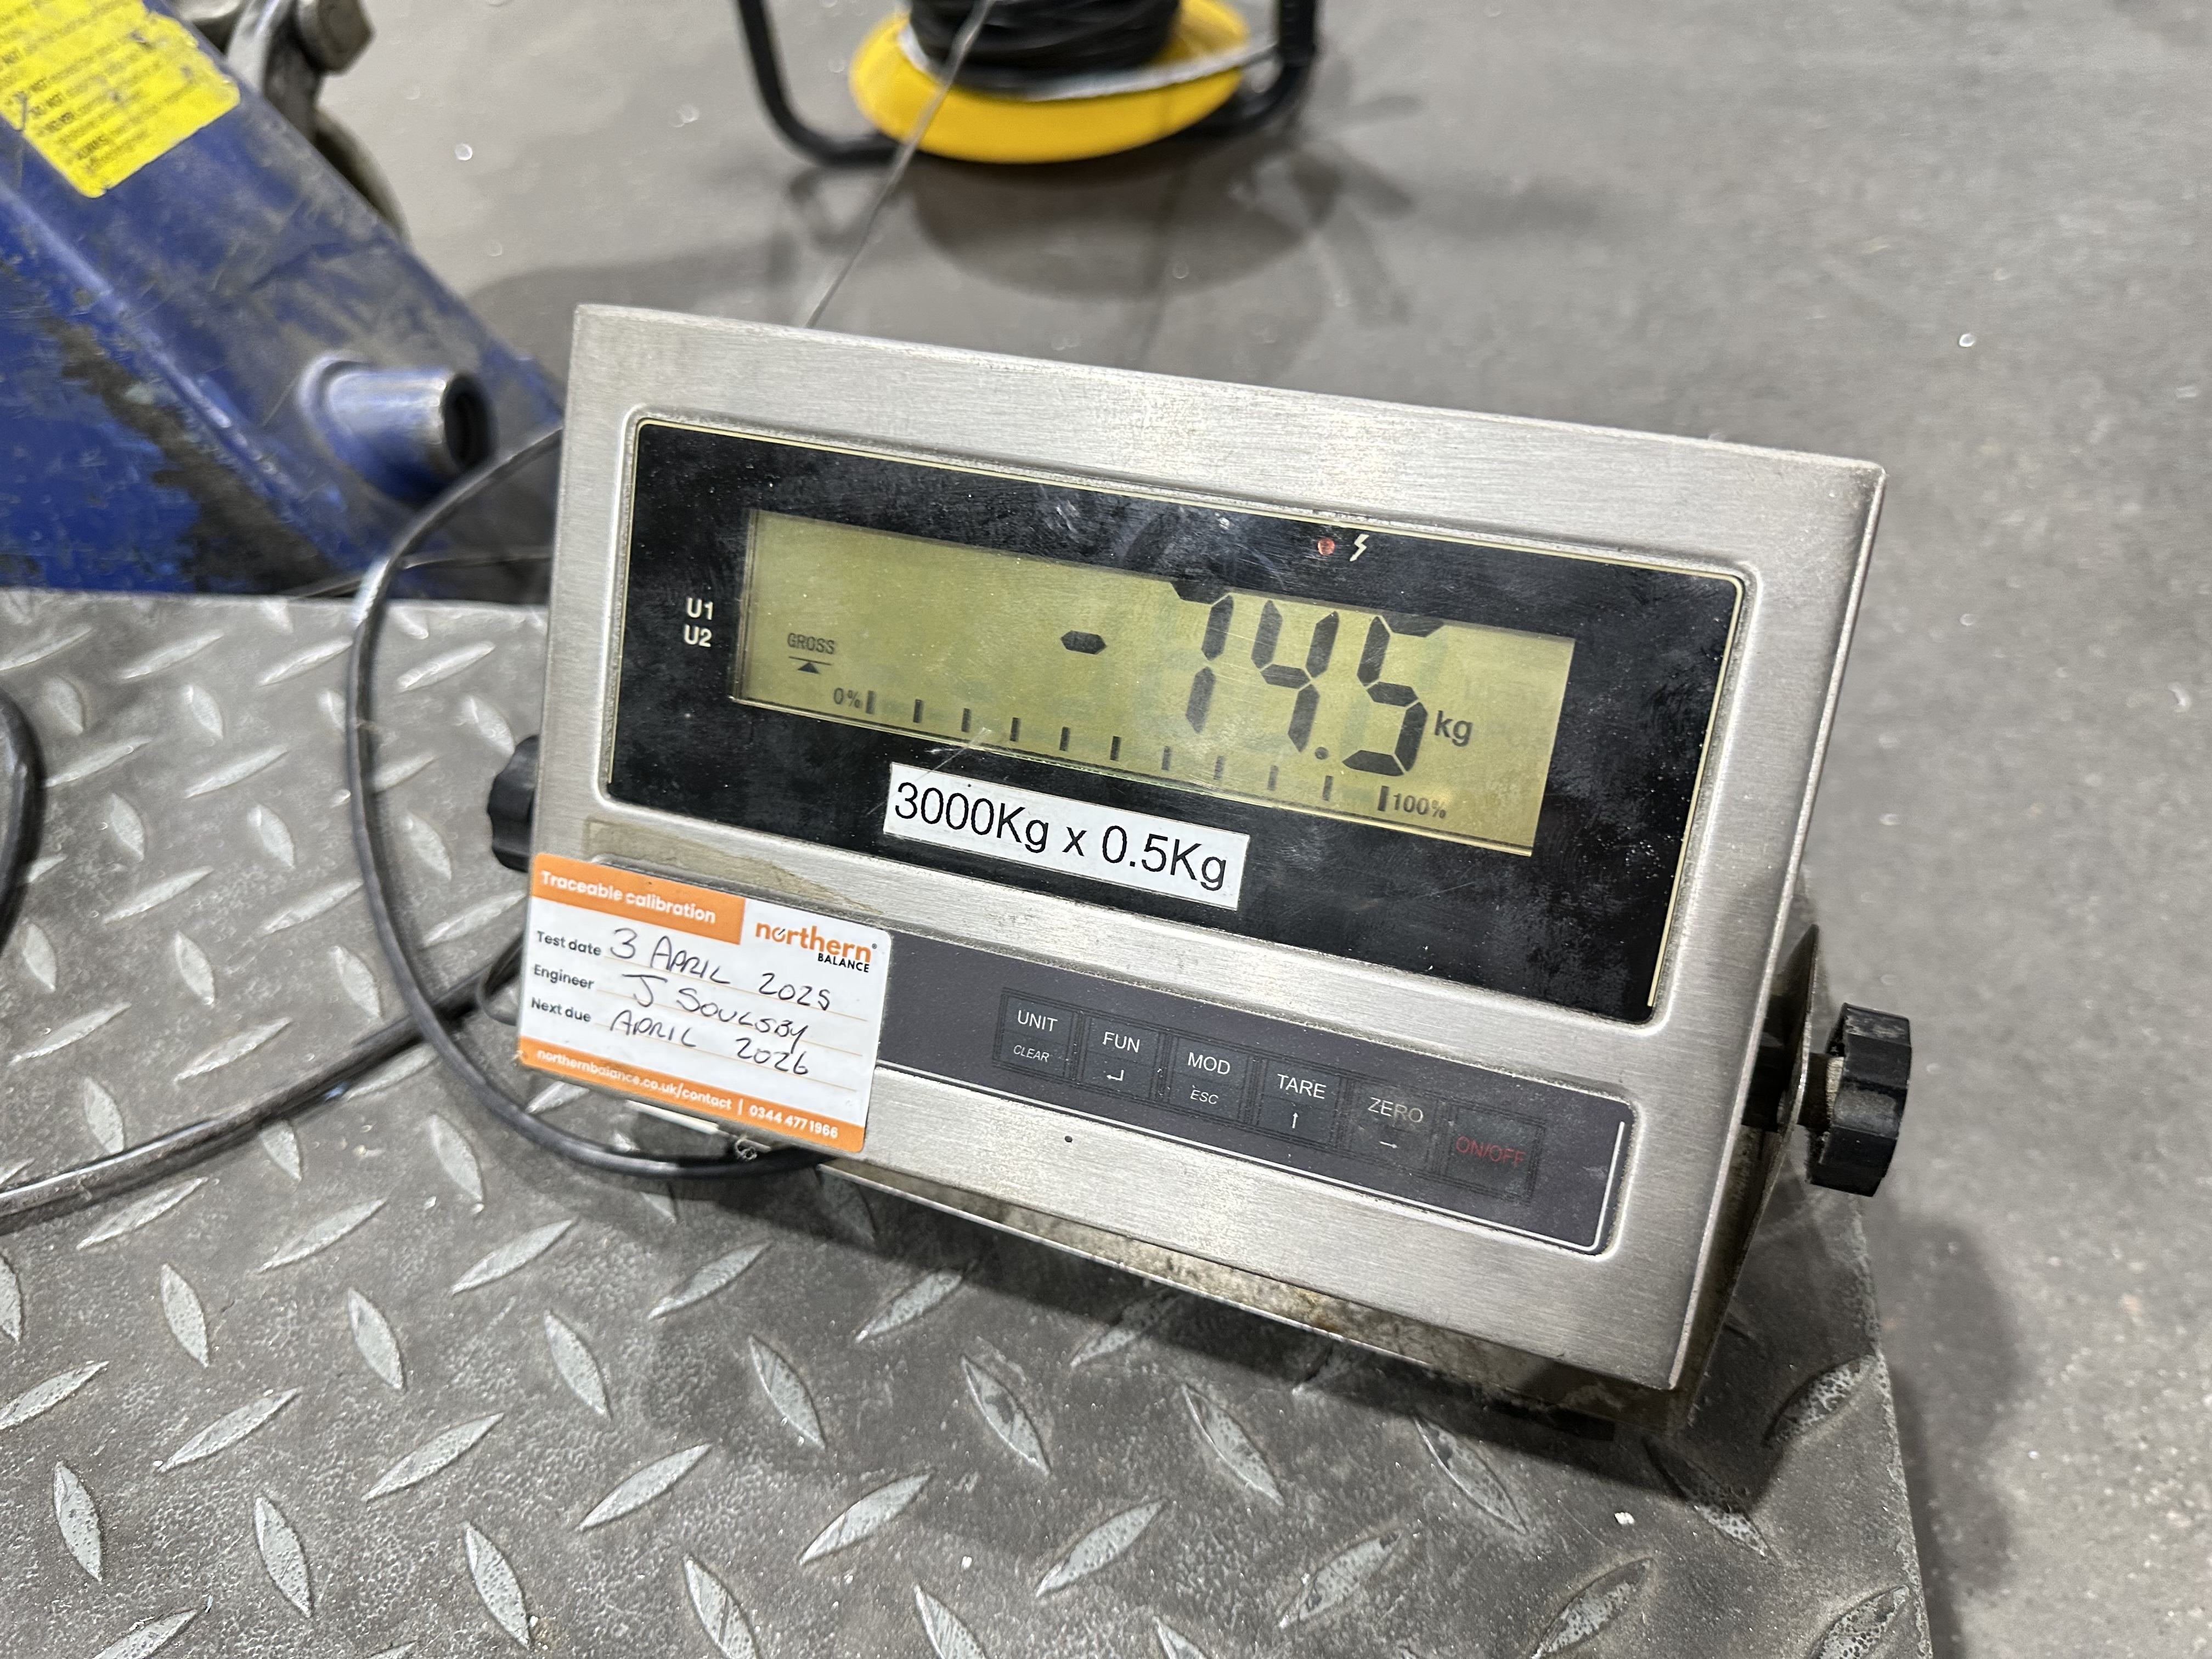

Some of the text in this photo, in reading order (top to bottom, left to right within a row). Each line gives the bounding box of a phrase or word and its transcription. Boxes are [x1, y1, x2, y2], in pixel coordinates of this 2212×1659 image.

[687, 597, 713, 620] U1
[685, 624, 712, 648] U2
[787, 633, 836, 654] GROSS
[833, 687, 864, 709] 0%
[1434, 710, 1473, 747] kg
[1393, 793, 1447, 819] 100%
[894, 782, 1227, 891] 3000Kg x 0.5Kg
[540, 870, 716, 923] Traceable calibration
[537, 930, 602, 956] Test date
[610, 927, 638, 960] 3
[758, 972, 831, 1011] 2025
[817, 952, 871, 973] BALANCE
[533, 964, 595, 990] Engineer
[621, 973, 669, 1008] J
[531, 996, 592, 1023] Next due
[1017, 1009, 1058, 1032] UNIT
[1012, 1045, 1051, 1063] CLEAR
[1102, 1031, 1141, 1053] FUN
[735, 1037, 809, 1075] 2026
[1187, 1052, 1231, 1075] MOD
[536, 1048, 733, 1110] northernbalance.co.uk/contact
[749, 1104, 783, 1124] 0344
[1189, 1089, 1220, 1105] ESC
[1277, 1073, 1327, 1100] TARE
[1367, 1097, 1424, 1123] ZERO
[1455, 1135, 1526, 1168] ON/OFF
